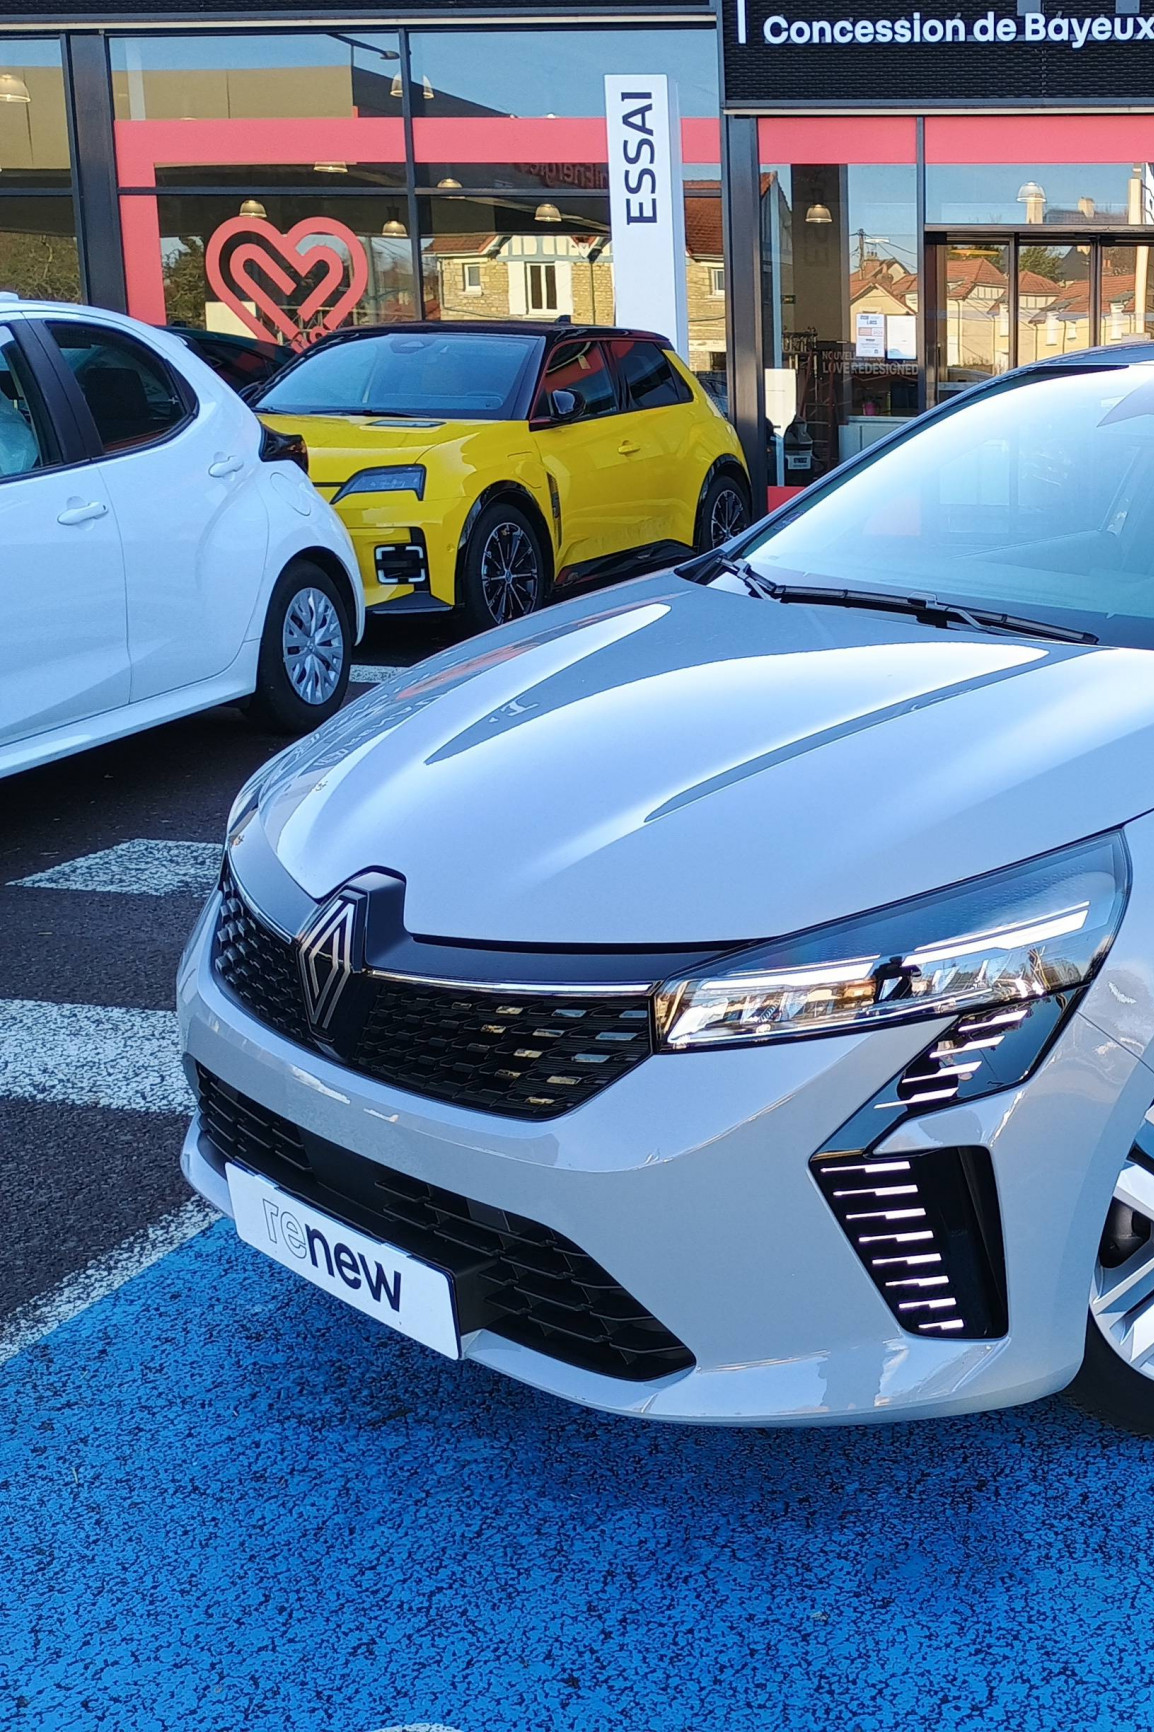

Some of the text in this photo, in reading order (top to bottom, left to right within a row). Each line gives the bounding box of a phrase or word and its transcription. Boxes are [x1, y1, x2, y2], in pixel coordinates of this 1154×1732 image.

[762, 12, 967, 44] Concession
[973, 11, 1017, 43] de
[620, 91, 658, 226] ESSAI
[822, 361, 919, 375] LOVE REDESIGNED
[262, 1198, 402, 1312] renew
